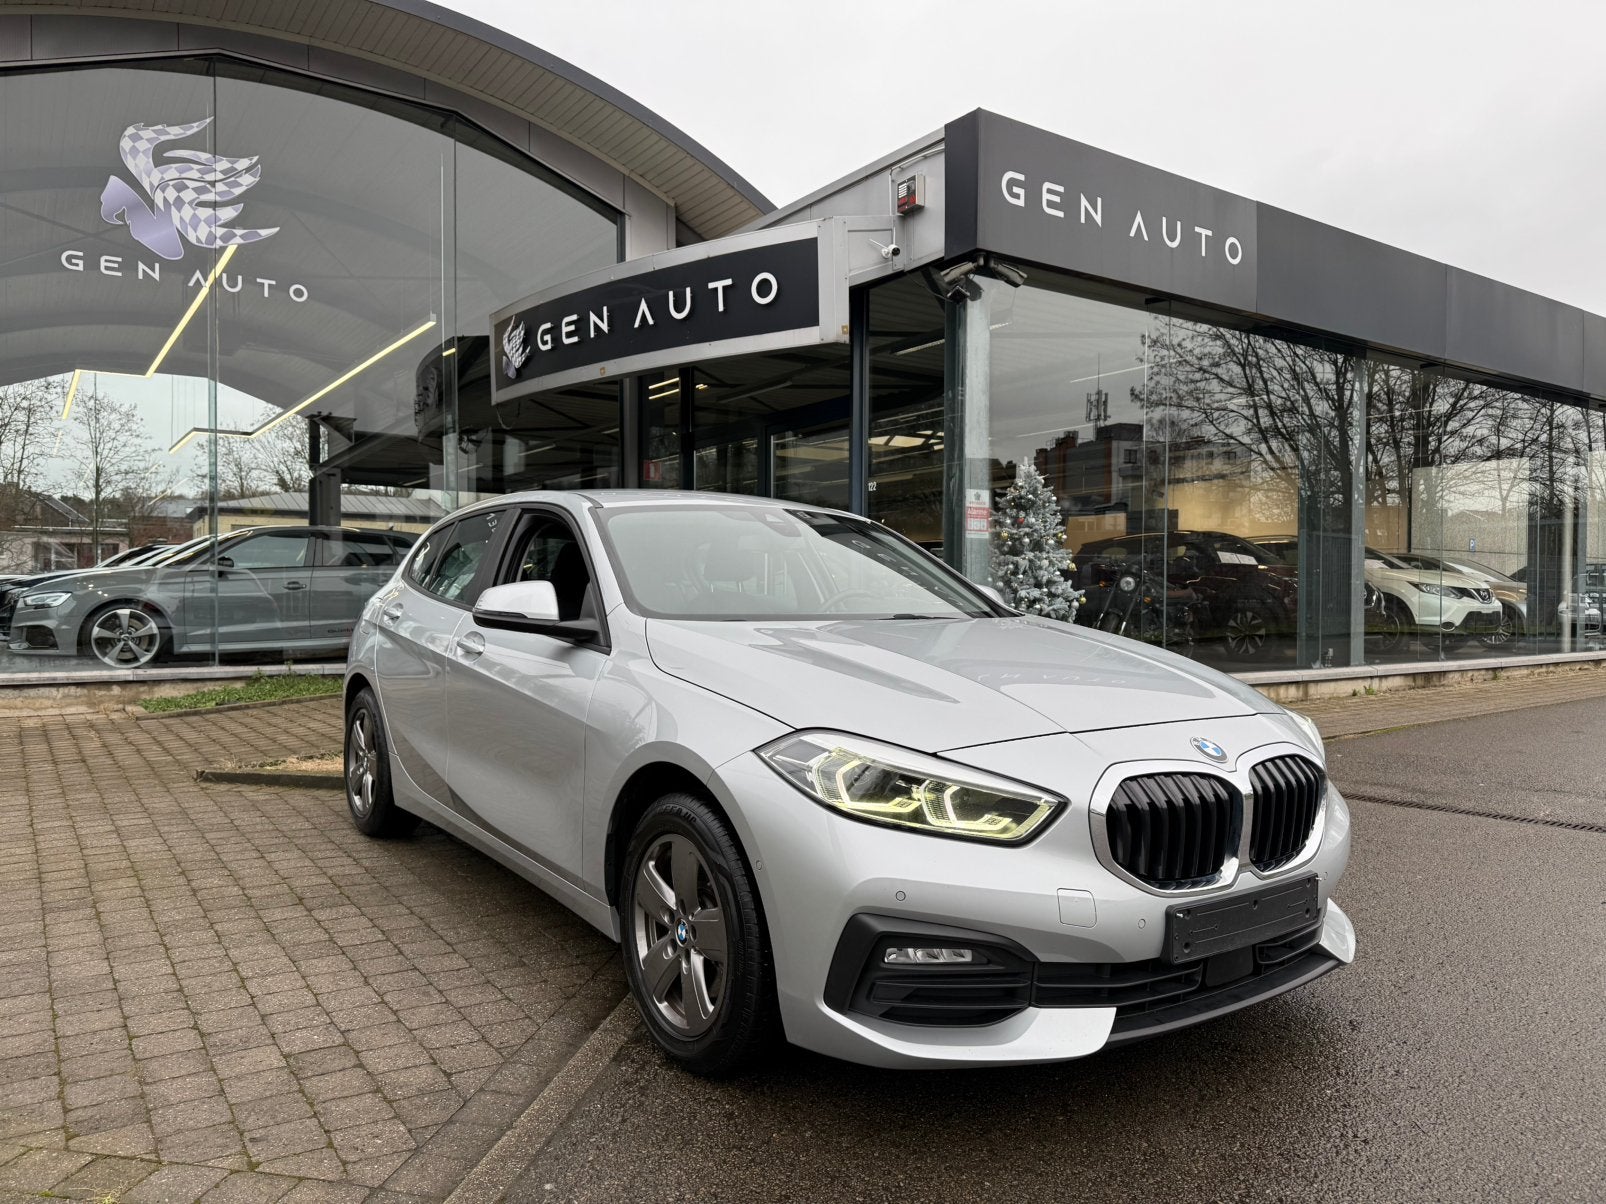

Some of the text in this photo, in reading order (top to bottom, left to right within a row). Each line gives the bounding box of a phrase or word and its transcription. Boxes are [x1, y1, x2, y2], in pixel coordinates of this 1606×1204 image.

[1001, 170, 1243, 265] GEN AUTO
[60, 250, 309, 302] GEN AUTO
[537, 272, 778, 351] GEN AUTO
